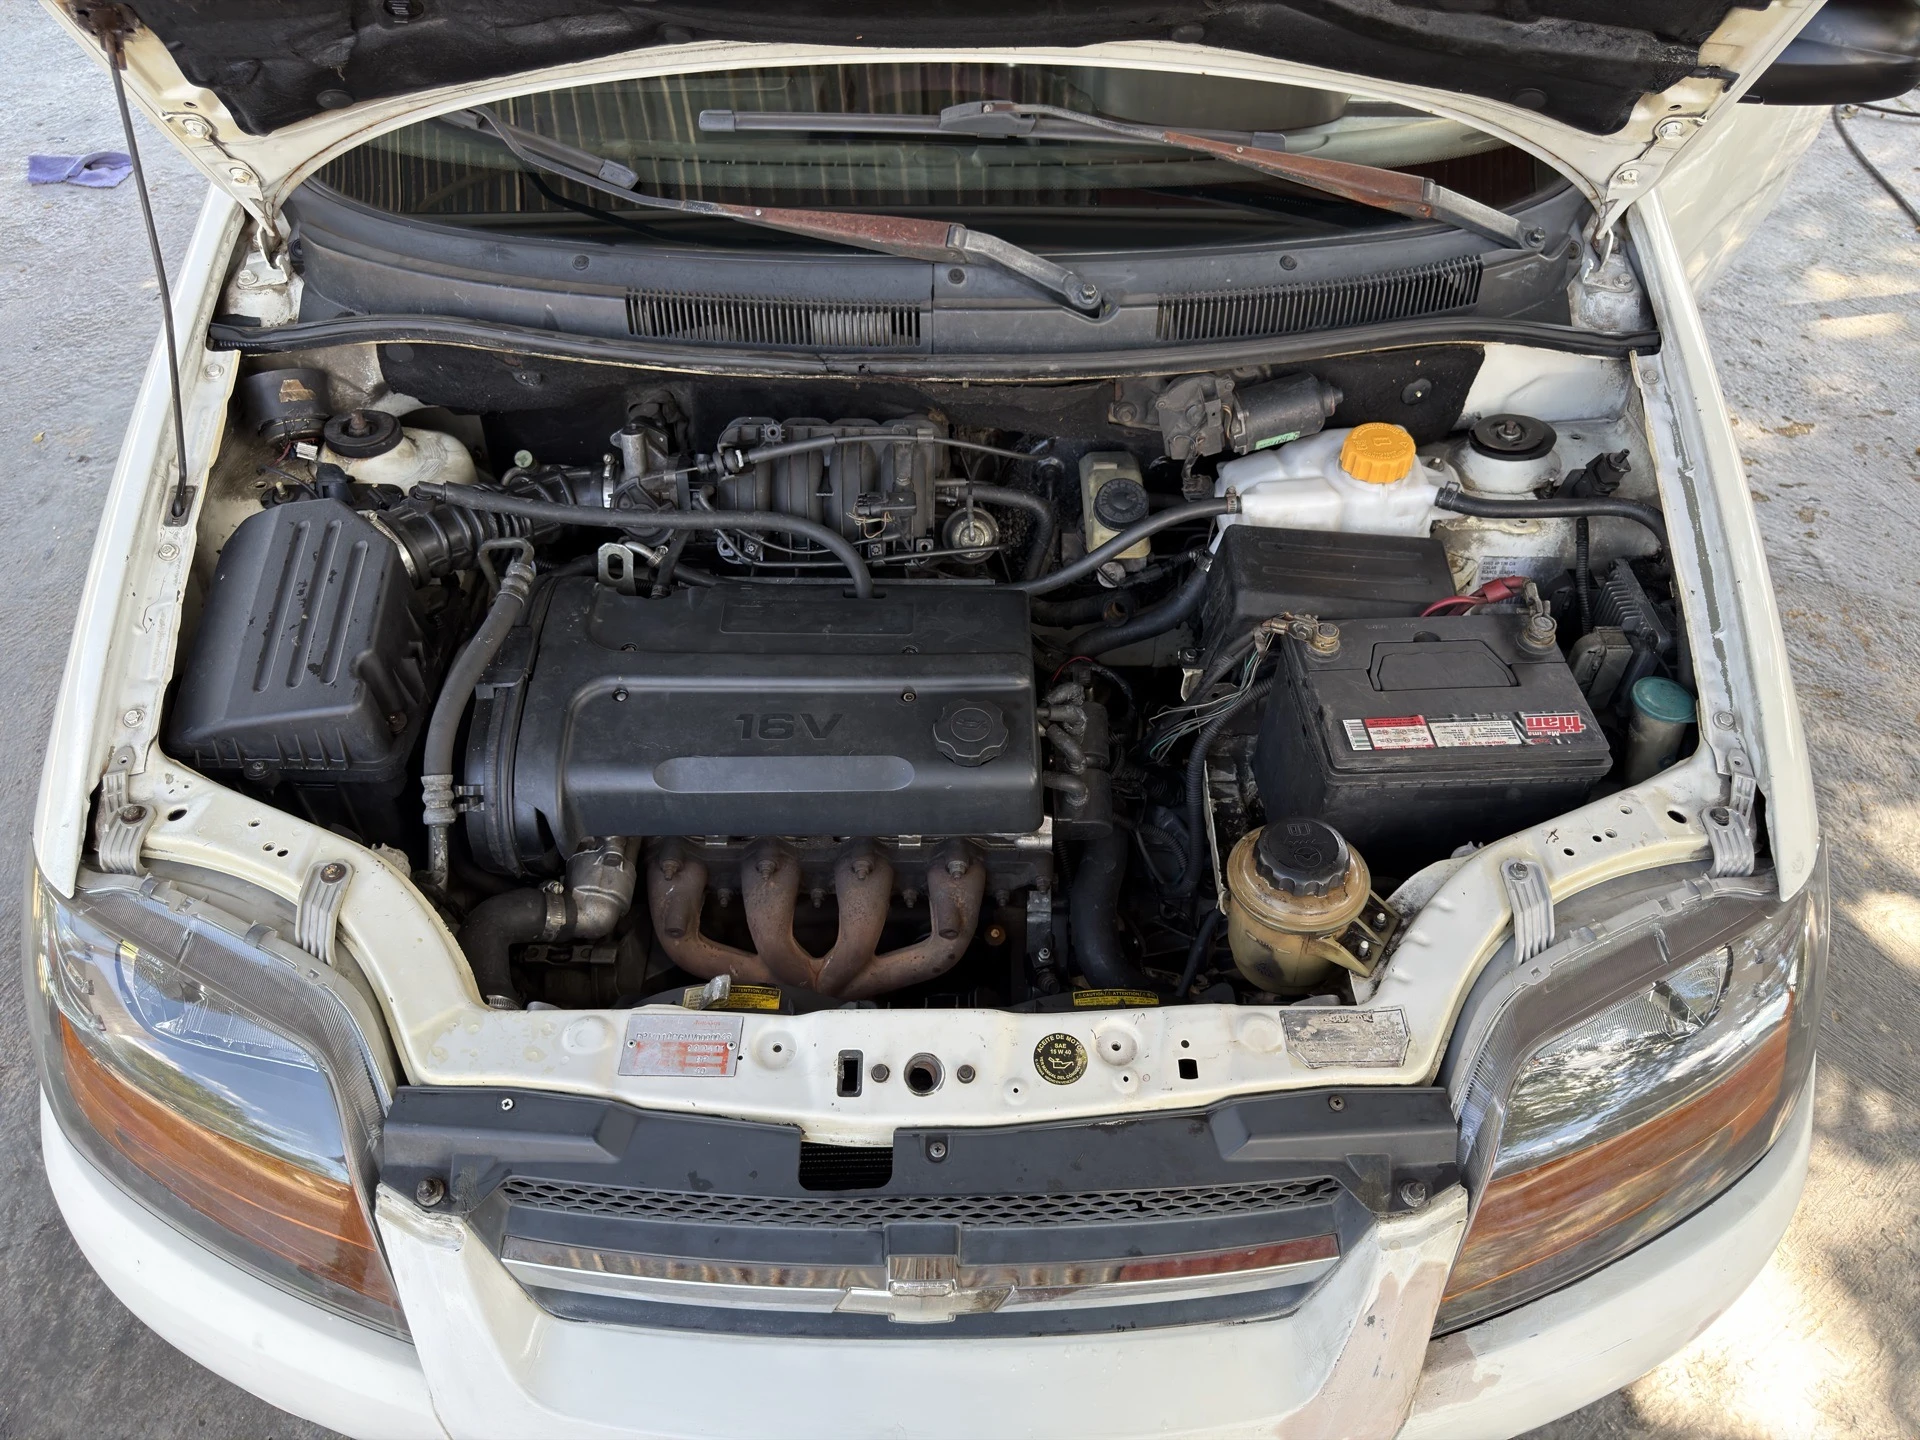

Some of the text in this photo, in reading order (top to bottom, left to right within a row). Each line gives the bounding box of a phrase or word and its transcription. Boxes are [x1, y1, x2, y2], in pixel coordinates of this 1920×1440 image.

[734, 712, 844, 740] 16V
[1526, 715, 1586, 734] titan
[1037, 1035, 1054, 1053] ACEITE
